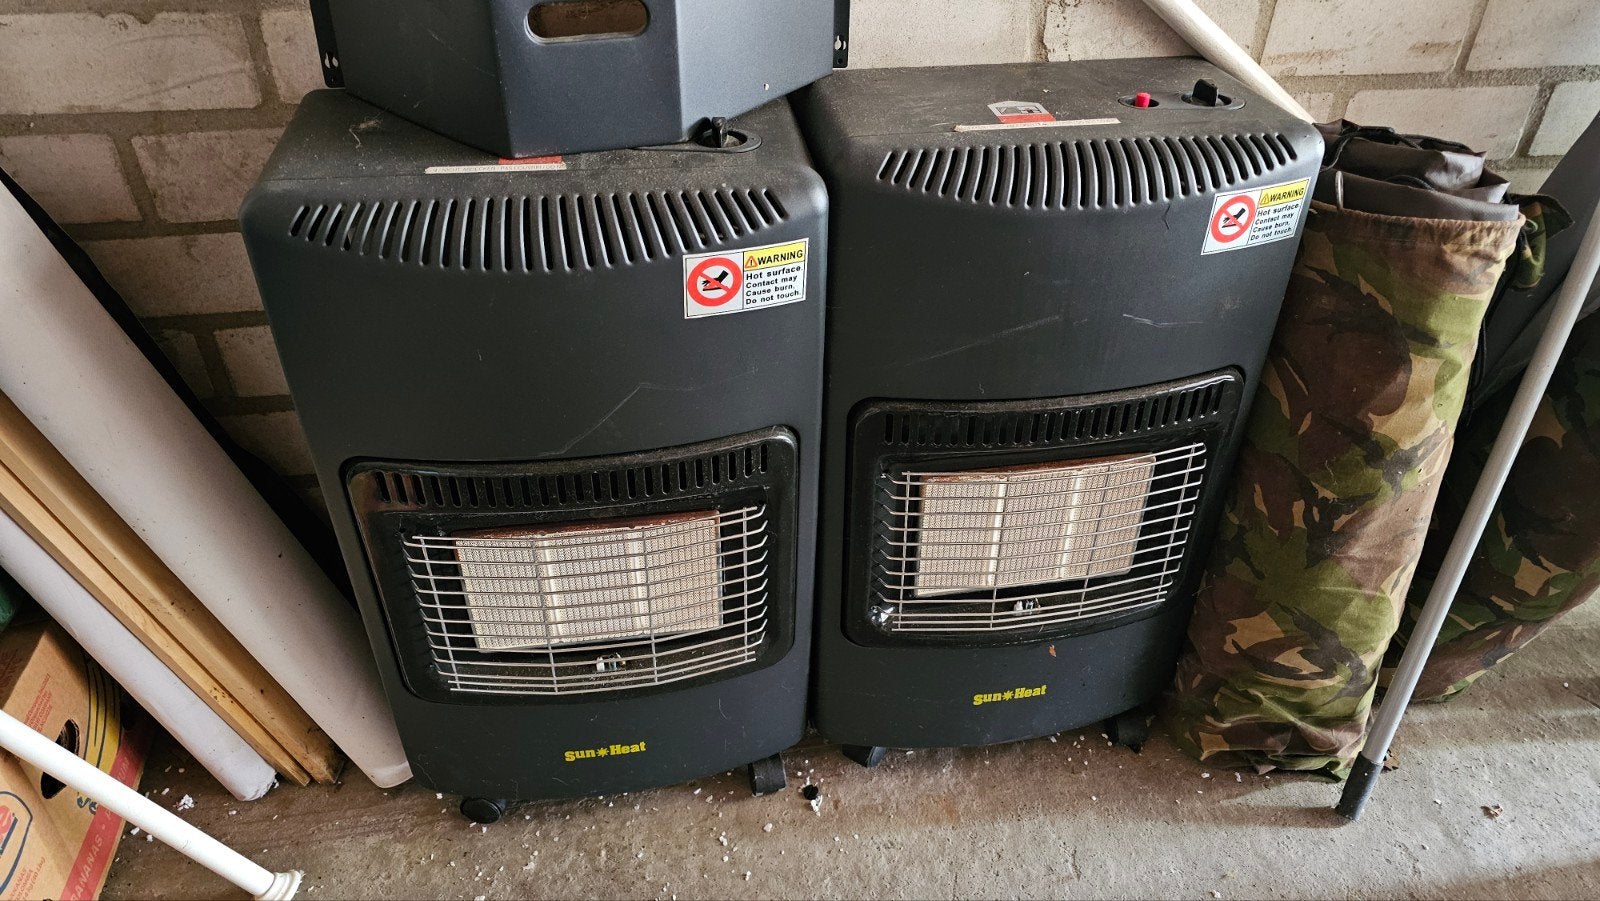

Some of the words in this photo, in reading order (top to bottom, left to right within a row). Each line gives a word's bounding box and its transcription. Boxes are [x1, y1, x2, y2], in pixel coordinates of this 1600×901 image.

[1269, 188, 1304, 202] WARNING
[1257, 208, 1270, 217] Hot
[1255, 216, 1280, 225] Contact
[1282, 212, 1294, 220] may
[1253, 225, 1272, 233] Cause
[1261, 231, 1272, 239] not
[757, 249, 803, 266] WARNING
[746, 272, 763, 280] Hot
[746, 278, 778, 288] Contact
[781, 275, 798, 283] may
[746, 288, 771, 296] Cause
[760, 295, 774, 303] not
[973, 693, 1002, 706] Sun
[1014, 684, 1047, 699] Heat
[564, 749, 596, 762] Sun
[609, 741, 646, 756] Heat
